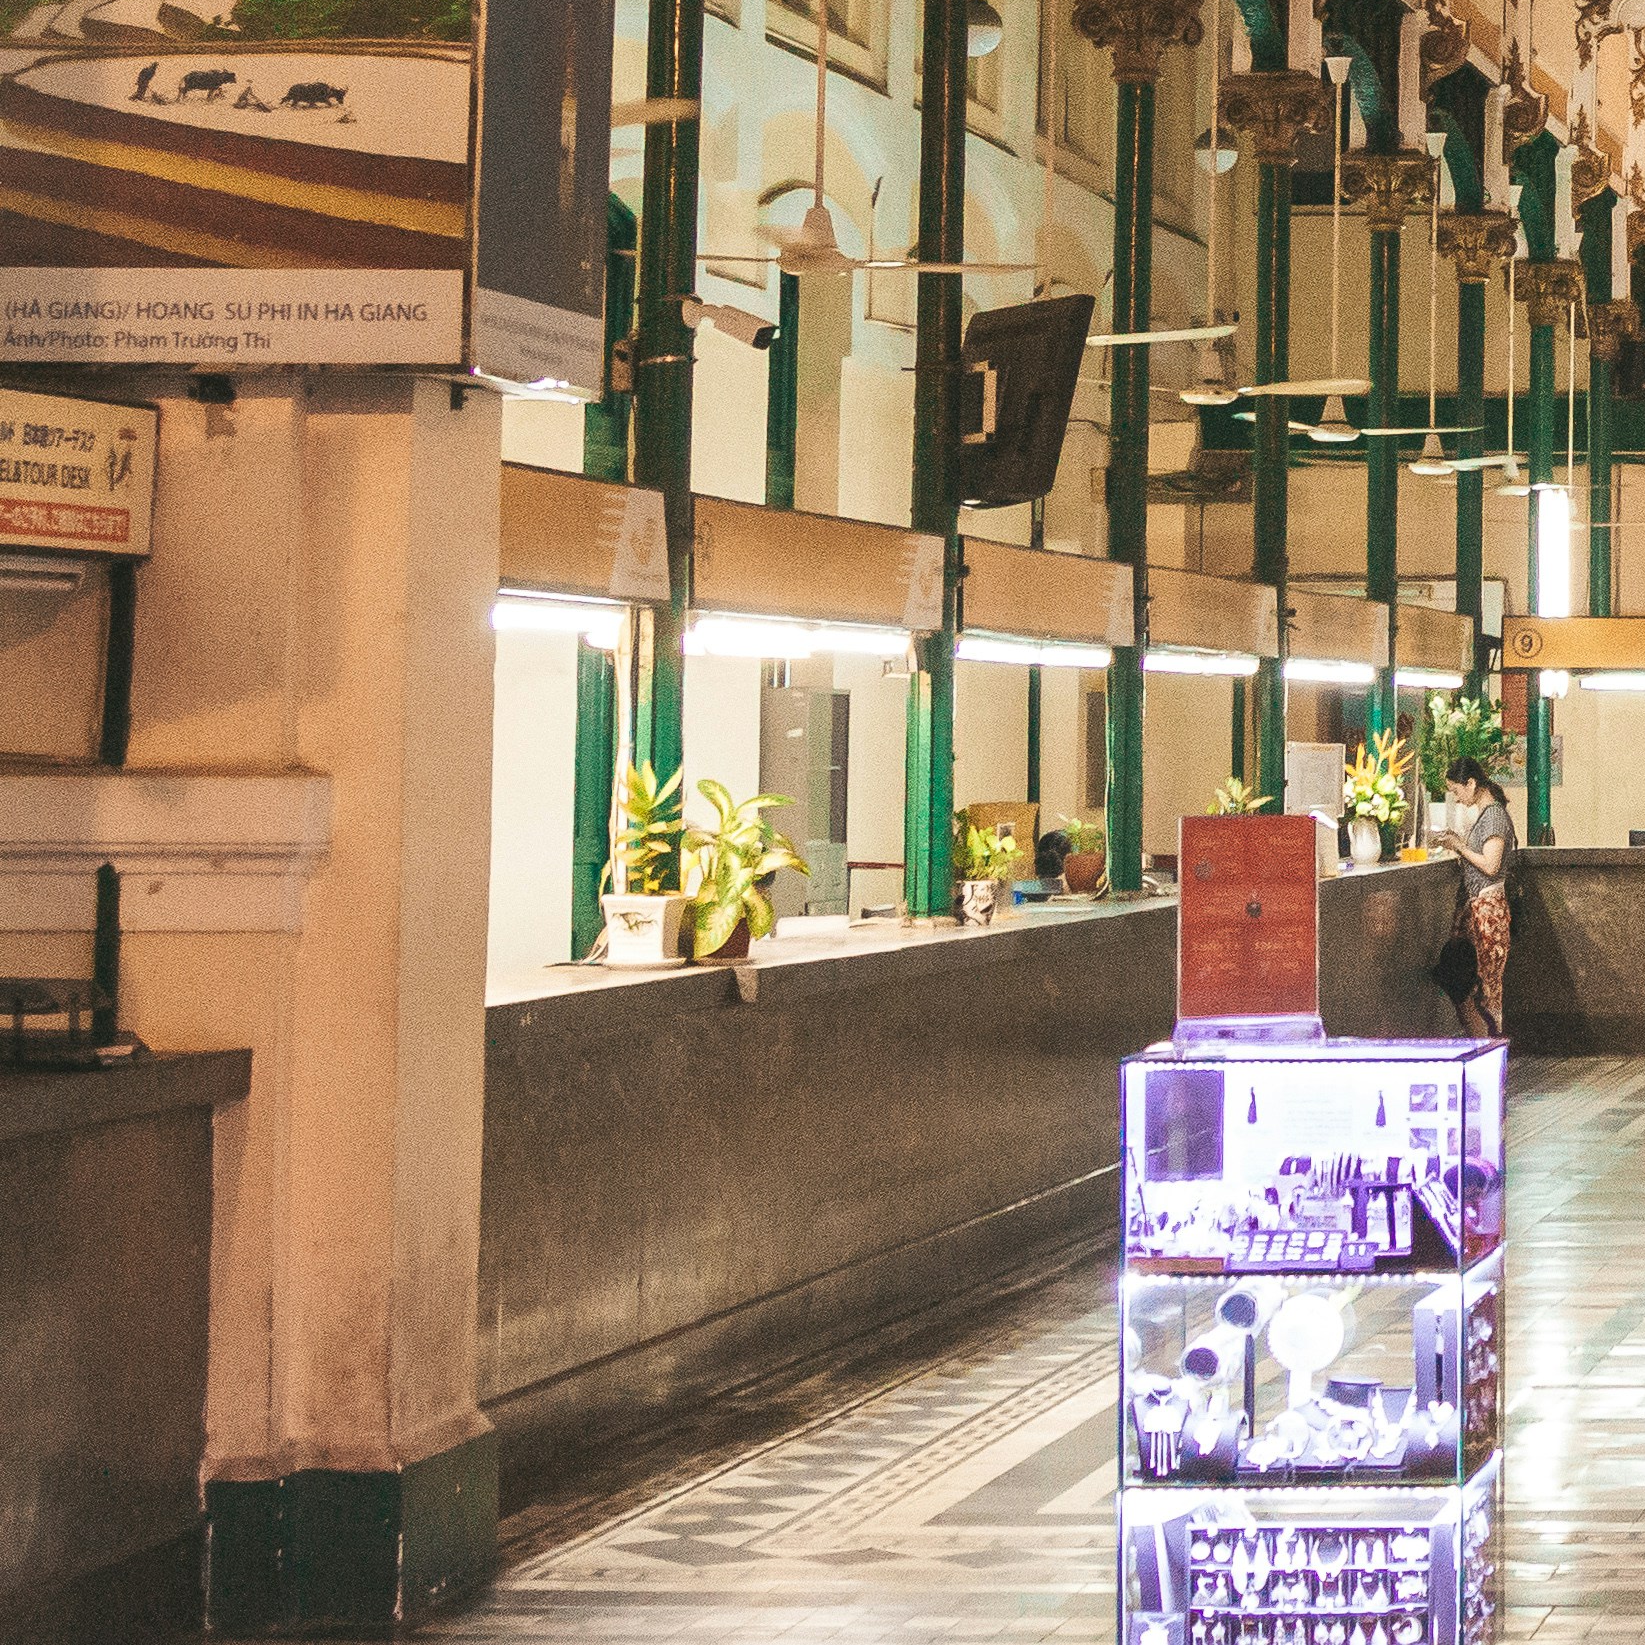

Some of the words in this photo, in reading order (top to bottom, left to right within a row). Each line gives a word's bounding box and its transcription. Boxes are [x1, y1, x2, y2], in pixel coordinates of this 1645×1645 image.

[136, 303, 214, 321] HOANG
[298, 303, 318, 321] IN
[325, 303, 354, 321] HA
[360, 303, 427, 321] GIANG
[114, 331, 167, 351] Phạm
